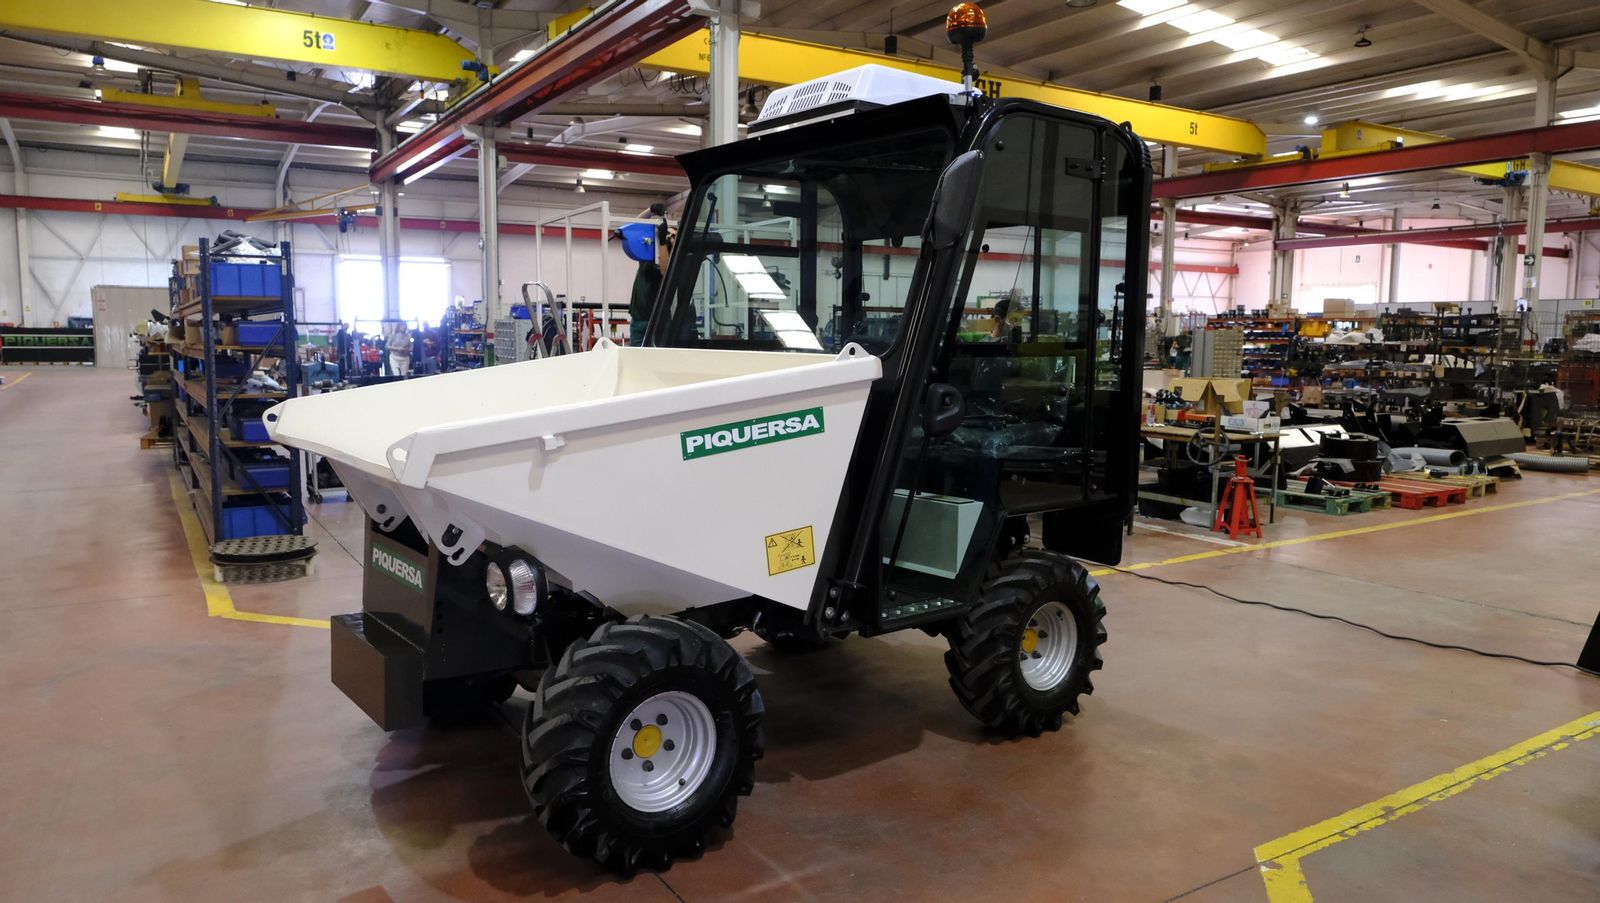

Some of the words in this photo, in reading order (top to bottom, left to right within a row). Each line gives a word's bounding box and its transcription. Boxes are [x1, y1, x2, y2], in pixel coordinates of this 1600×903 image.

[303, 30, 321, 49] 5t
[1189, 122, 1198, 136] 5t
[686, 414, 820, 453] PIQUERSA
[373, 547, 422, 588] PIQUERSA
